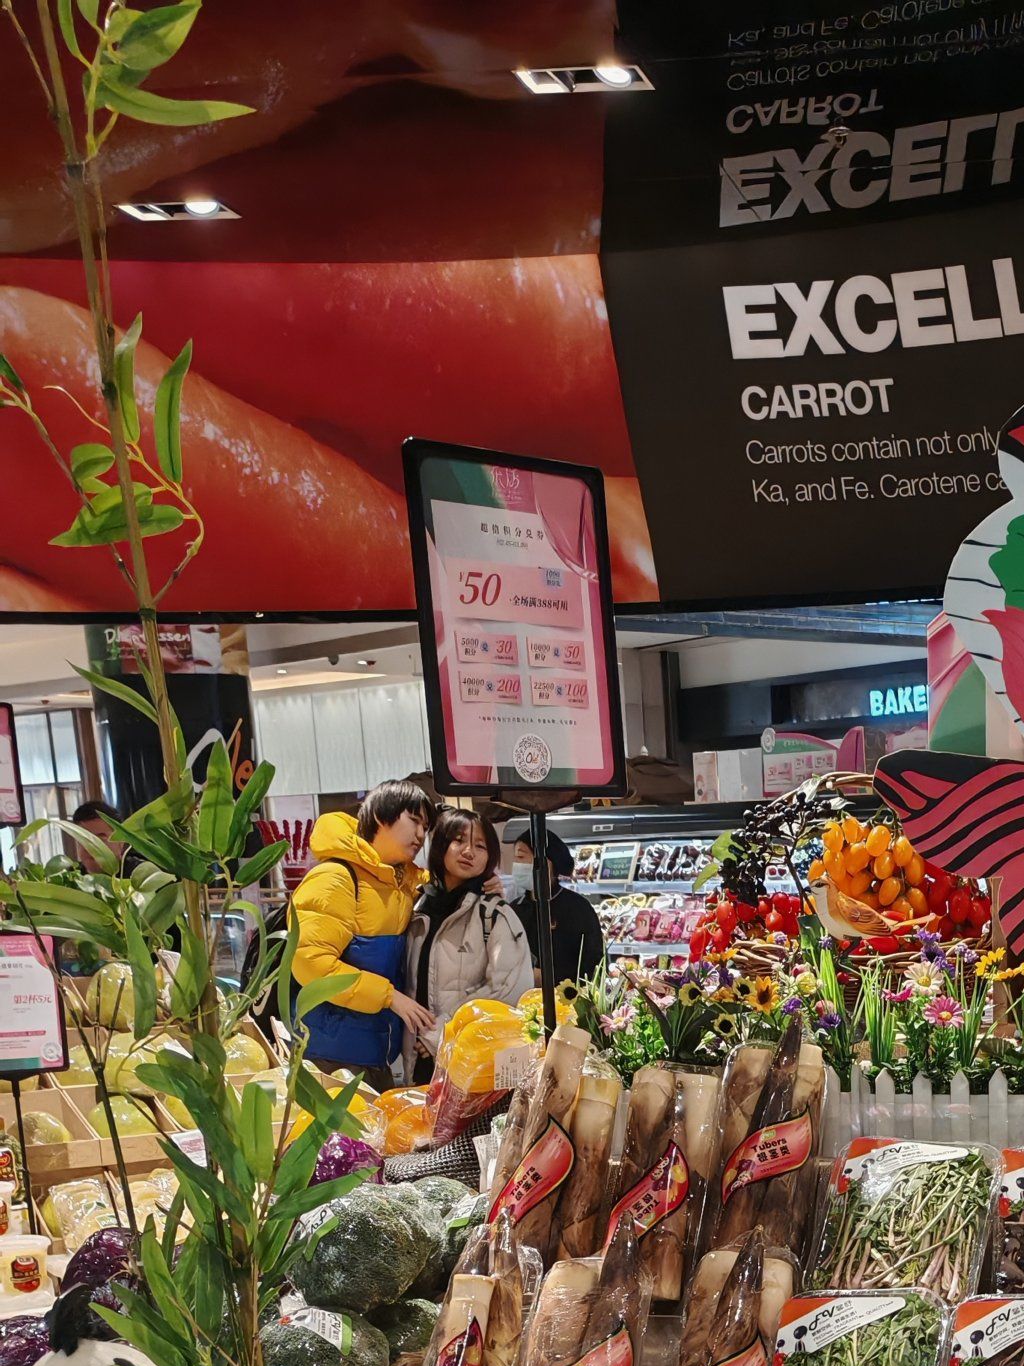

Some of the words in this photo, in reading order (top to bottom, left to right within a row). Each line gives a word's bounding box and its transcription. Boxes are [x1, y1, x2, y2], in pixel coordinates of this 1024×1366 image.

[741, 378, 894, 421] CARROT
[746, 439, 827, 464] Carrots
[831, 434, 911, 461] contain
[916, 430, 953, 457] not
[957, 425, 1000, 456] only
[752, 479, 789, 504] Ka,
[795, 477, 836, 500] and
[840, 477, 874, 500] Fe.
[879, 472, 981, 498] Carotene
[985, 473, 1007, 490] ca
[869, 685, 928, 717] BAKE
[751, 1137, 787, 1154] Tubers
